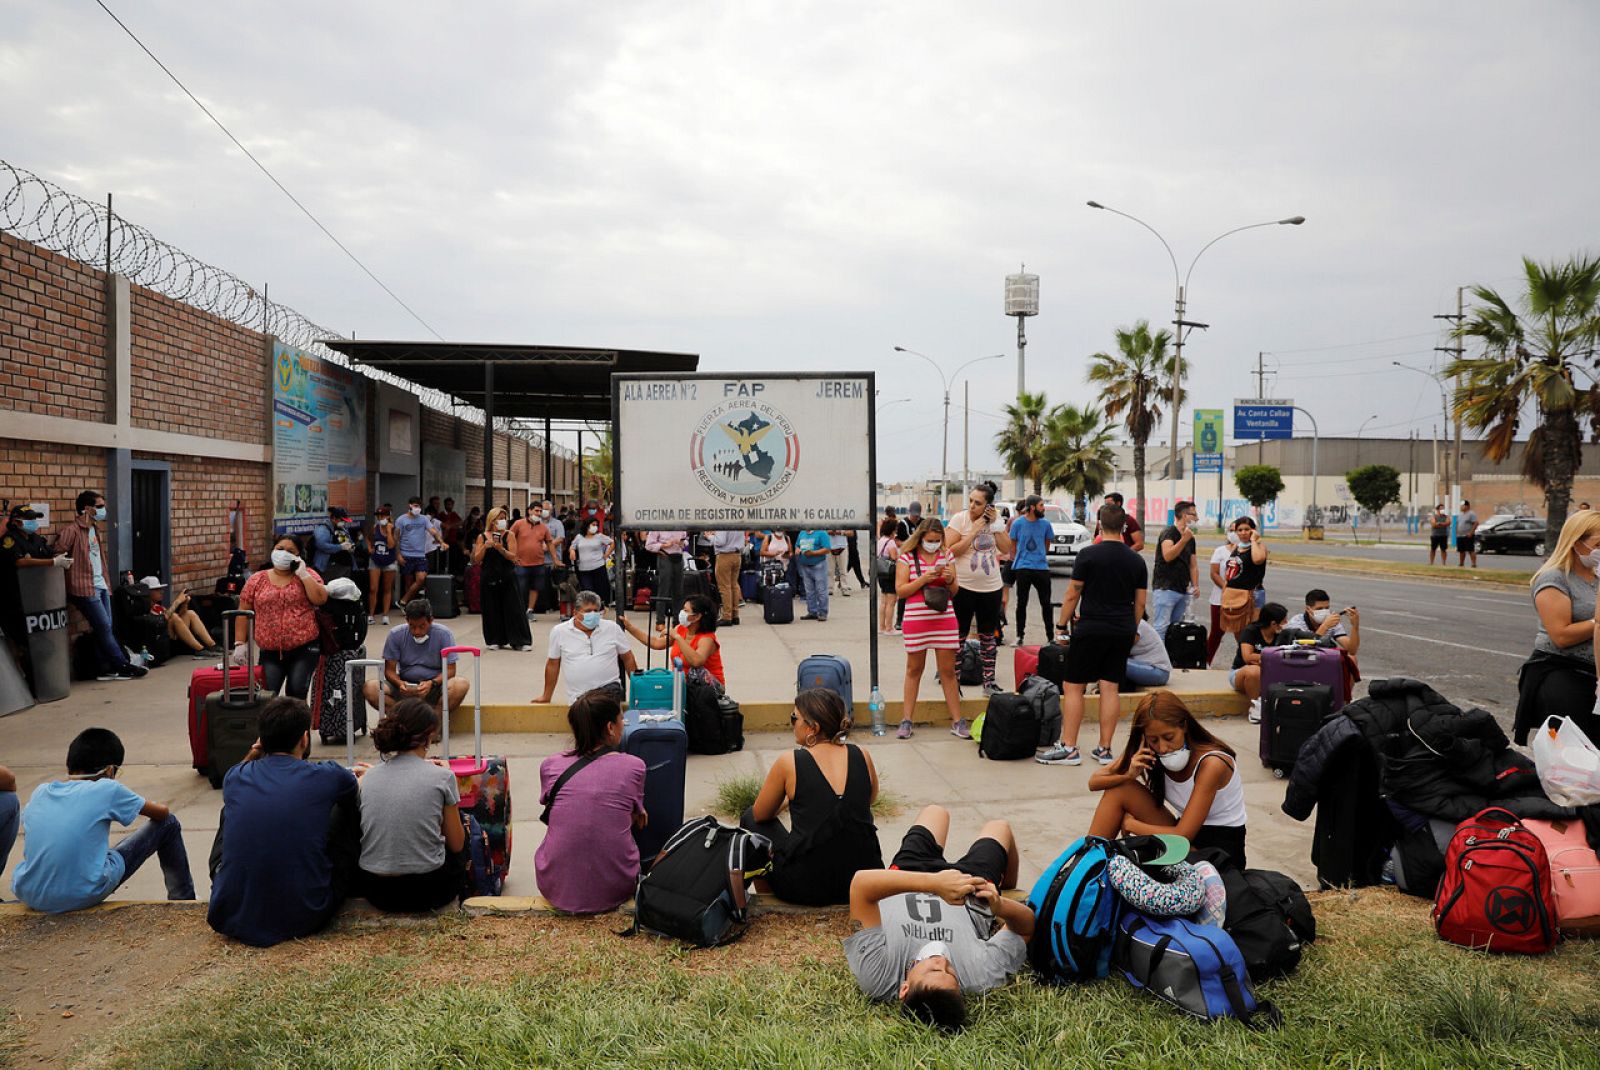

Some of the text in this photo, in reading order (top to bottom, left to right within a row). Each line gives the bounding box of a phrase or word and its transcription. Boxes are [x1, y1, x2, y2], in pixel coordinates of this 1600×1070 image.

[624, 383, 644, 401] ALA
[646, 383, 678, 401] AEREA
[723, 383, 766, 397] FAP
[816, 382, 863, 398] JEREM
[697, 400, 793, 435] FUERZA AEREA DEL PERU
[1248, 409, 1268, 417] Canta
[1269, 409, 1291, 417] Callao
[698, 469, 792, 504] RESERVA Y MOVILIZACION
[634, 509, 676, 520] OFICINA
[678, 509, 691, 520] DE
[694, 508, 745, 520] REGISTRO
[747, 508, 787, 520] MILITAR
[803, 508, 815, 520] 16
[818, 509, 856, 520] CALLAO
[901, 923, 953, 943] CAPTAIN
